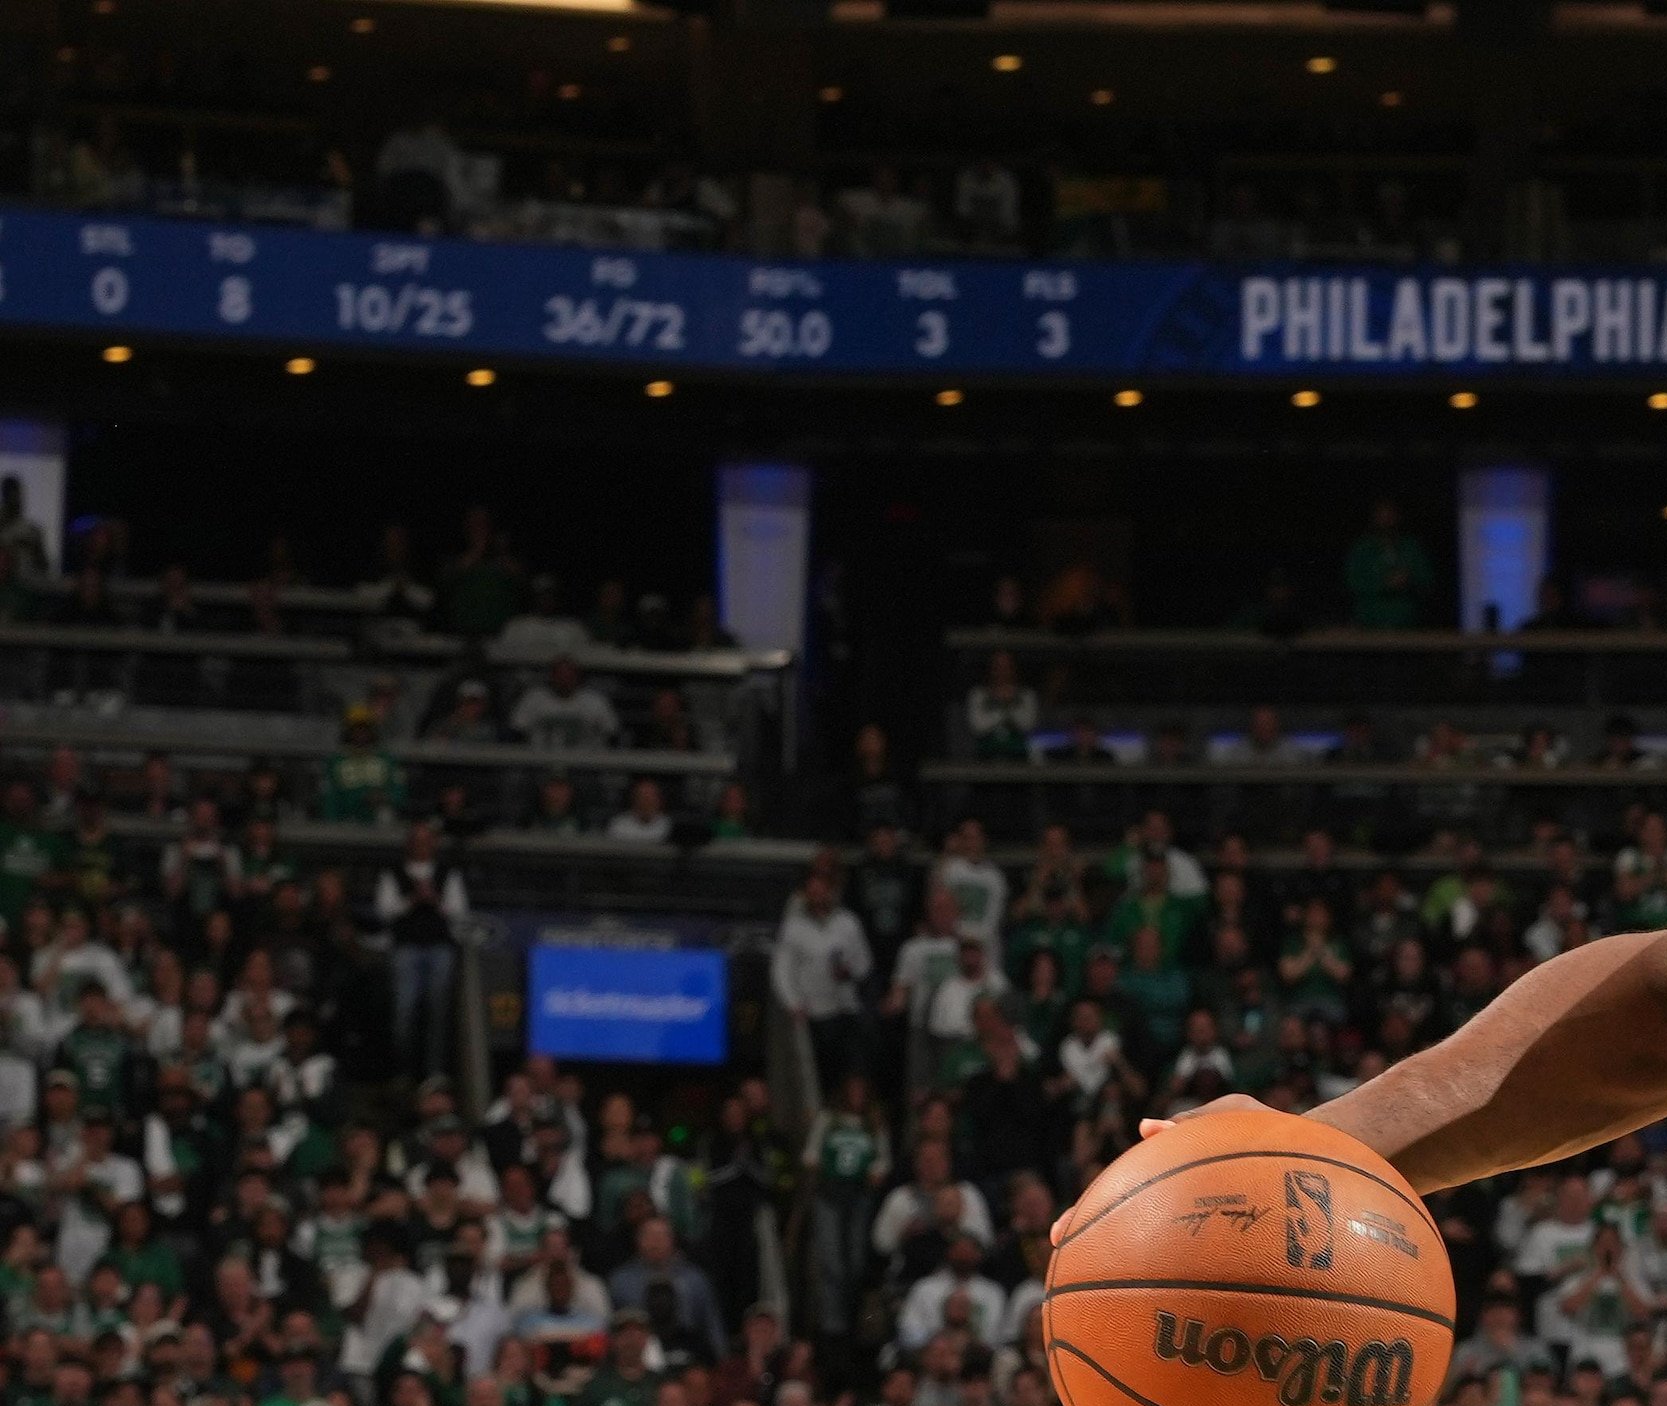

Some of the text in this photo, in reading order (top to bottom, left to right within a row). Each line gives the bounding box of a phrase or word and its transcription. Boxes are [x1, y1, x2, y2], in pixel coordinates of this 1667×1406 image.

[91, 267, 129, 315] 0
[219, 276, 252, 323] 8
[335, 283, 474, 338] 10/25
[544, 295, 686, 350] 36/72
[737, 308, 832, 358] 50.0
[916, 311, 949, 358] 3
[1038, 311, 1071, 359] 3
